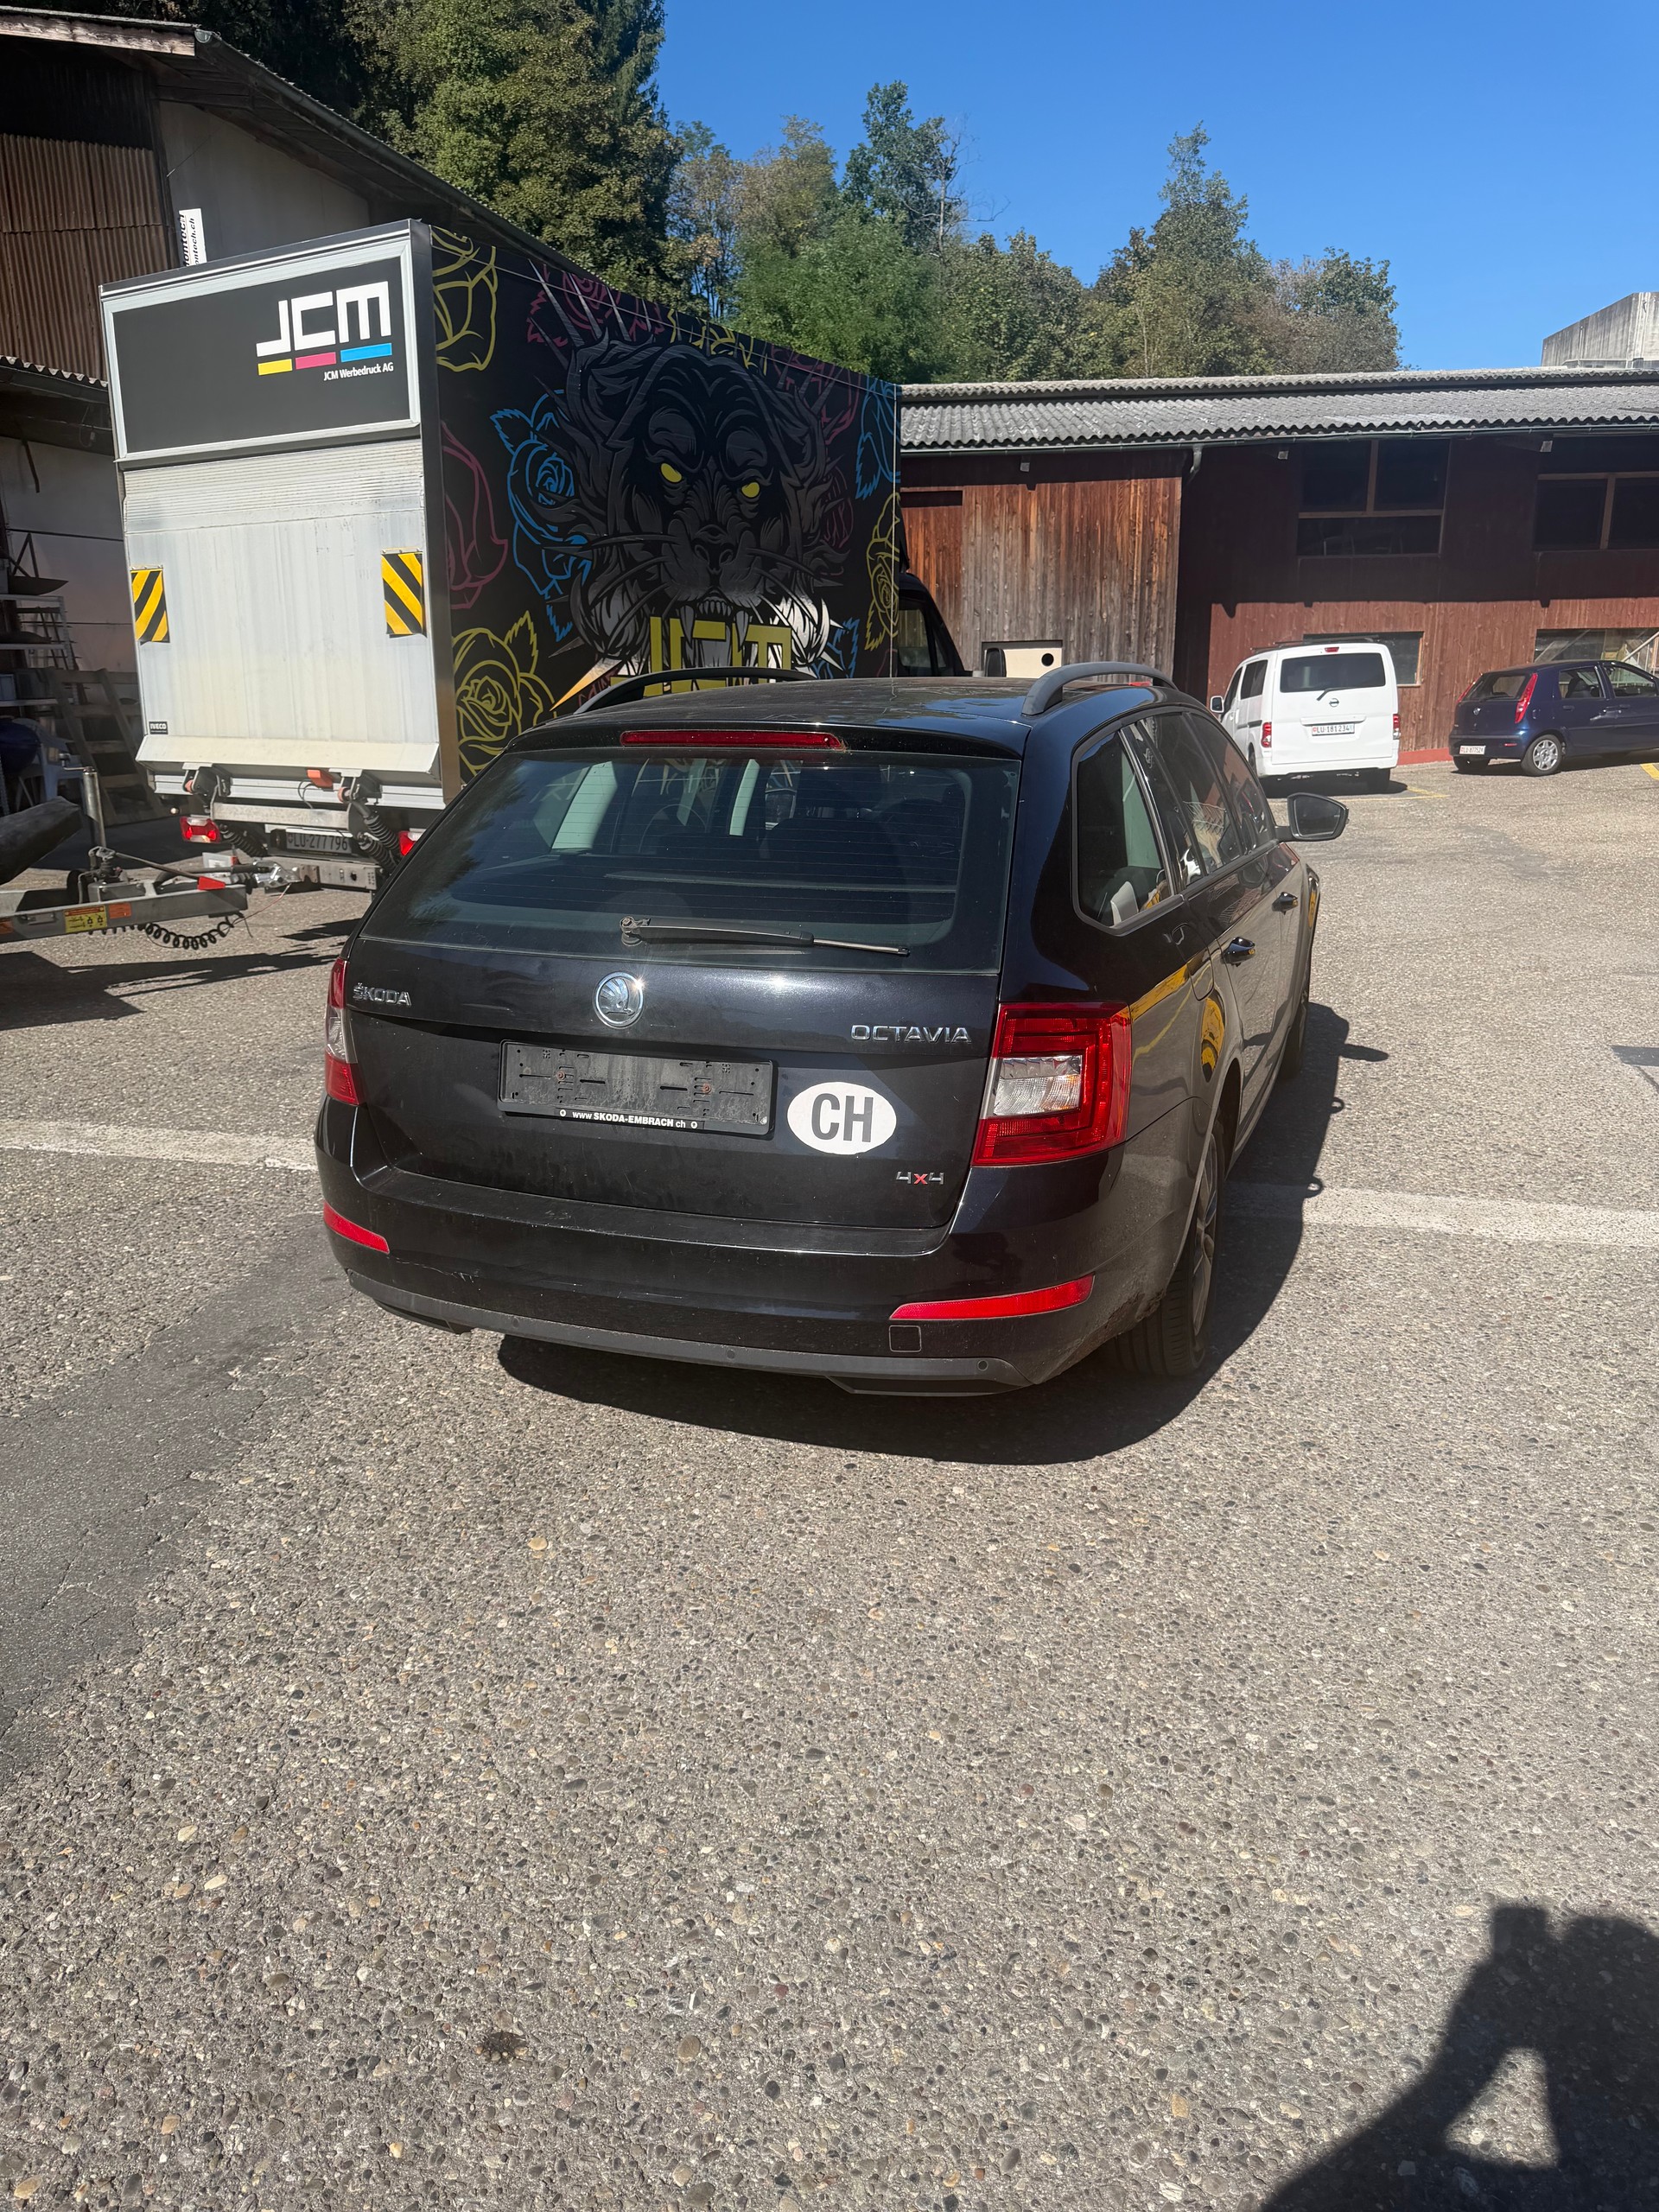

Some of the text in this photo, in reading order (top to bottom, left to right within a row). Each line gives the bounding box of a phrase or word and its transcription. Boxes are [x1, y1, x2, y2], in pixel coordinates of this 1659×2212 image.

[256, 281, 391, 357] JCM
[323, 362, 394, 381] JCM Werbedruck AG
[353, 982, 412, 1007] ŠKODA
[850, 1025, 972, 1044] OCTAVIA
[811, 1093, 874, 1142] CH
